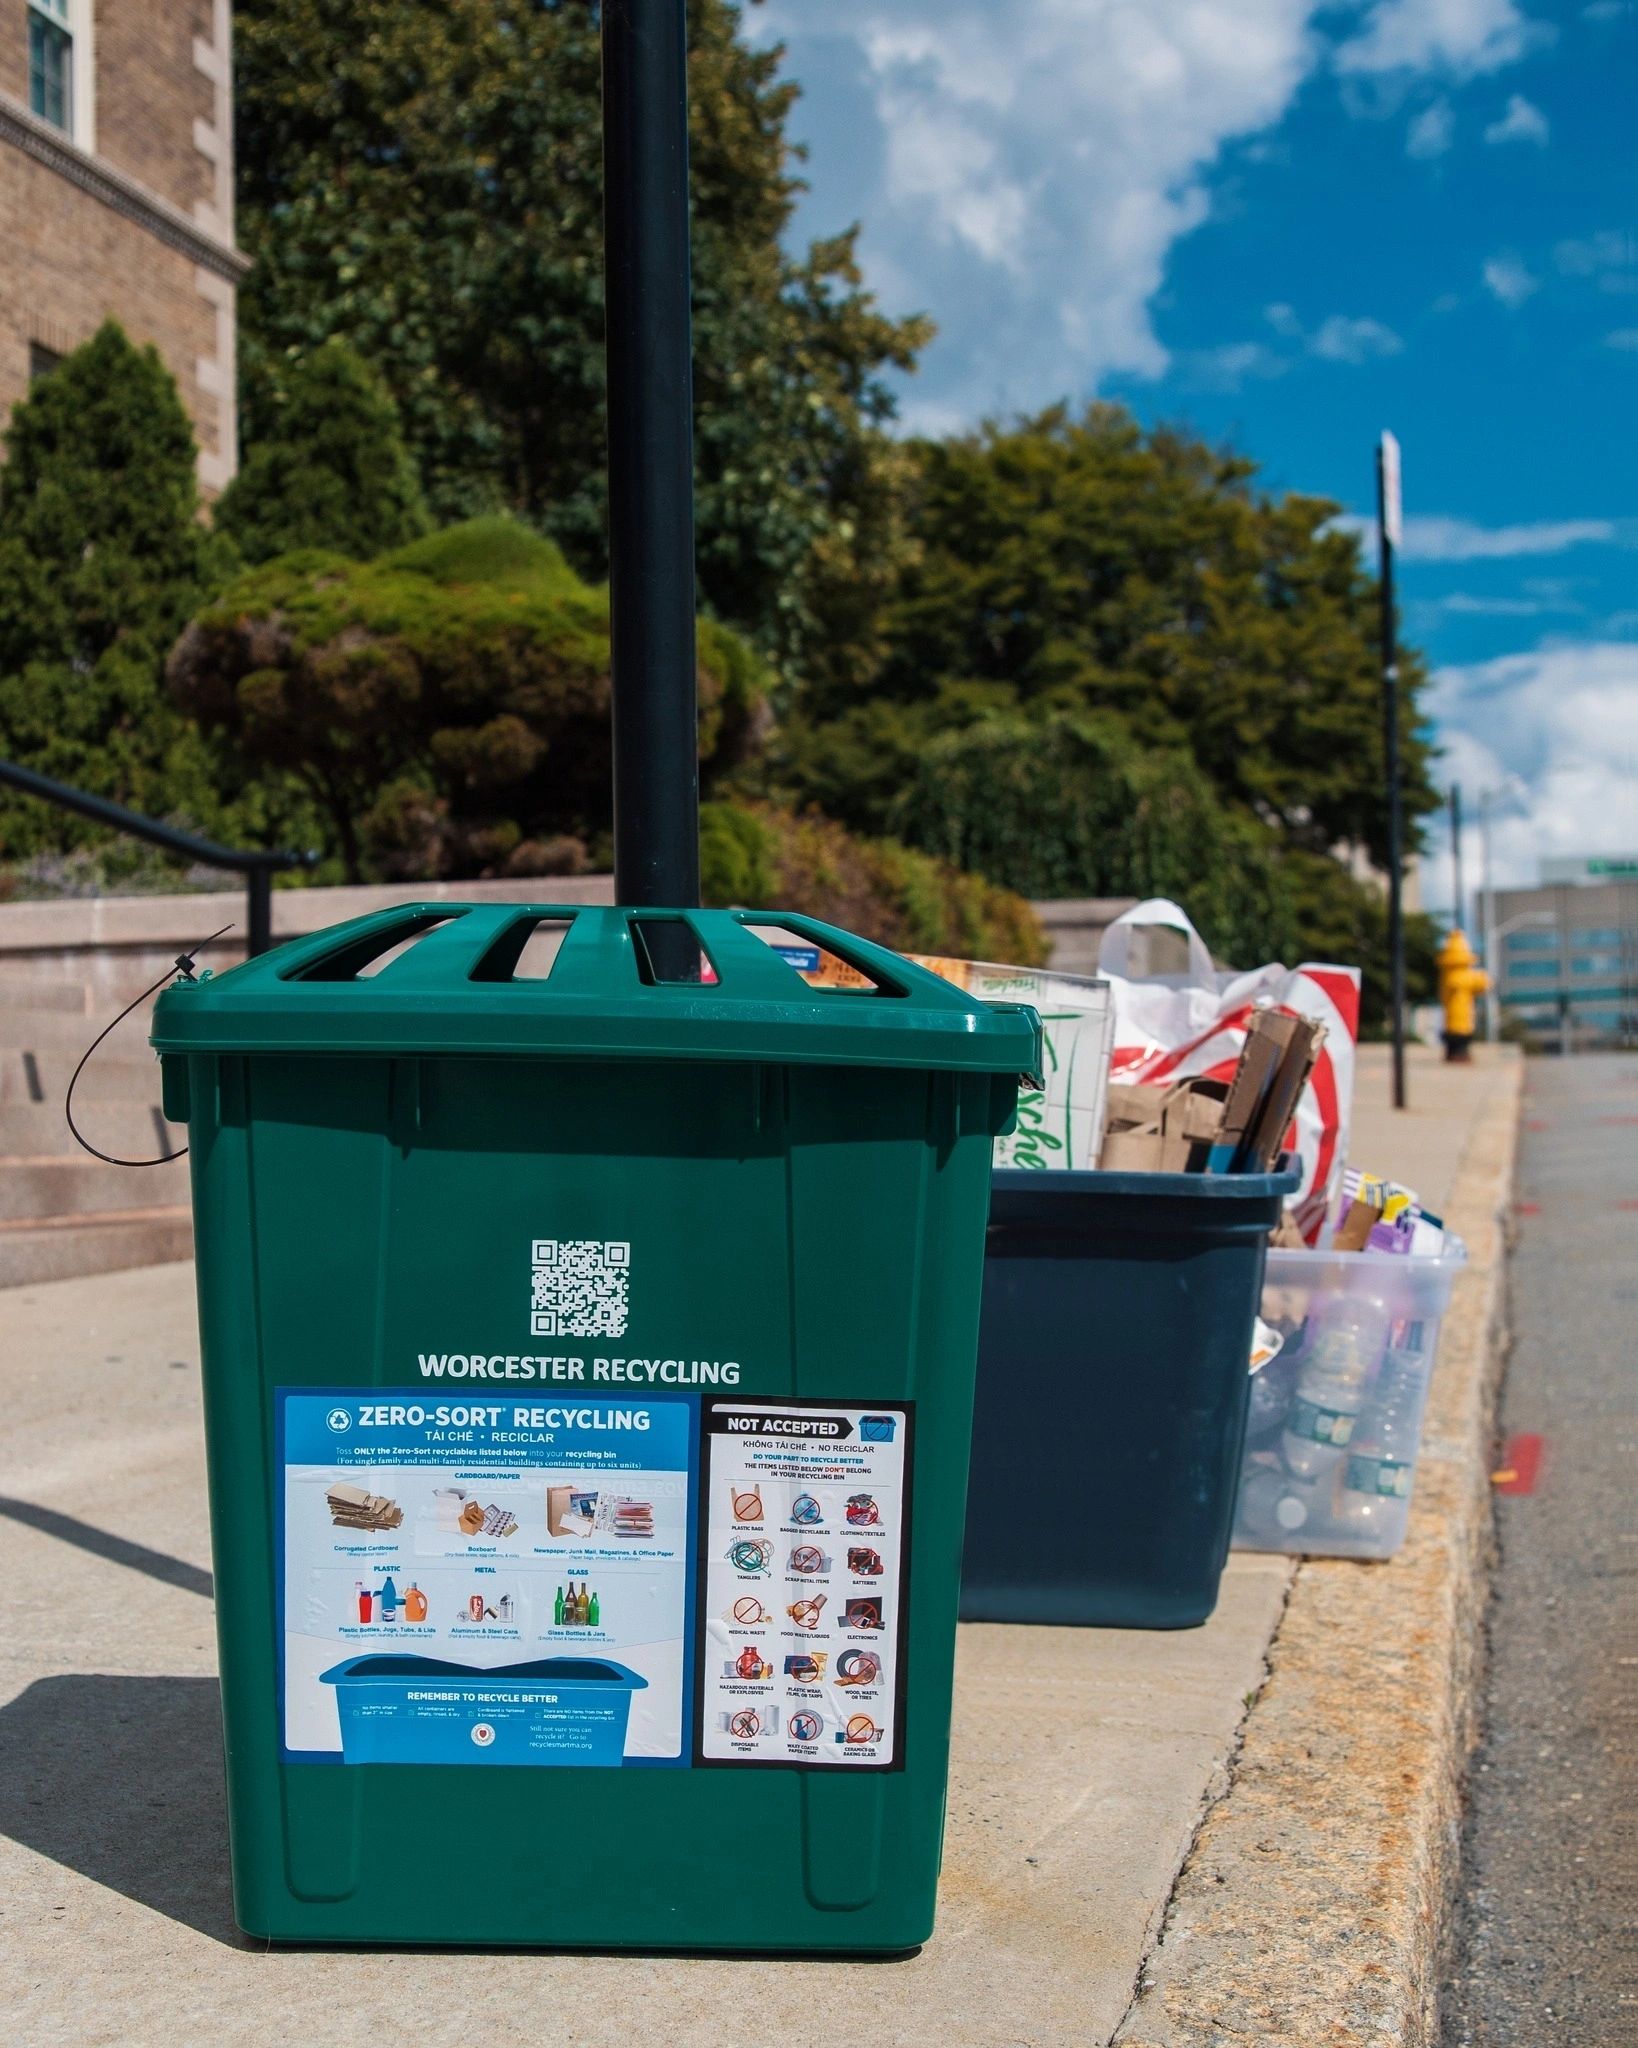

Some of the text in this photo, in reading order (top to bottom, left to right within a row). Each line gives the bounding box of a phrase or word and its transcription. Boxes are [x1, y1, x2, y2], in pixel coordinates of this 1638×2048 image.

[417, 1354, 740, 1385] WORCESTER RECYCLING
[514, 1408, 650, 1430] RECYCLING
[727, 1418, 839, 1435] NOT ACCEPTED
[425, 1430, 444, 1441] TÁI
[491, 1432, 554, 1443] RECICLAR
[336, 1447, 617, 1460] Toss ONLY the Zero-Sort recyclables listed below into your recycling bin
[818, 1444, 830, 1452] NO
[833, 1444, 875, 1453] RECICLAR
[337, 1457, 354, 1465] (For
[355, 1457, 378, 1466] single
[378, 1457, 401, 1466] family
[419, 1458, 467, 1466] multi-family
[508, 1459, 544, 1467] buildings
[544, 1460, 585, 1469] containing
[619, 1461, 642, 1469] units)
[810, 1456, 838, 1464] RECYCLE
[454, 1472, 521, 1480] CARDBOARD/PAPER
[797, 1472, 832, 1480] RECYCLING
[534, 1547, 568, 1555] Newspaper,
[599, 1549, 630, 1557] Magazines,
[657, 1550, 674, 1558] Paper
[407, 1692, 558, 1703] REMEMBER TO RECYCLE BETTER
[529, 1741, 592, 1750] recyclesmartma.org
